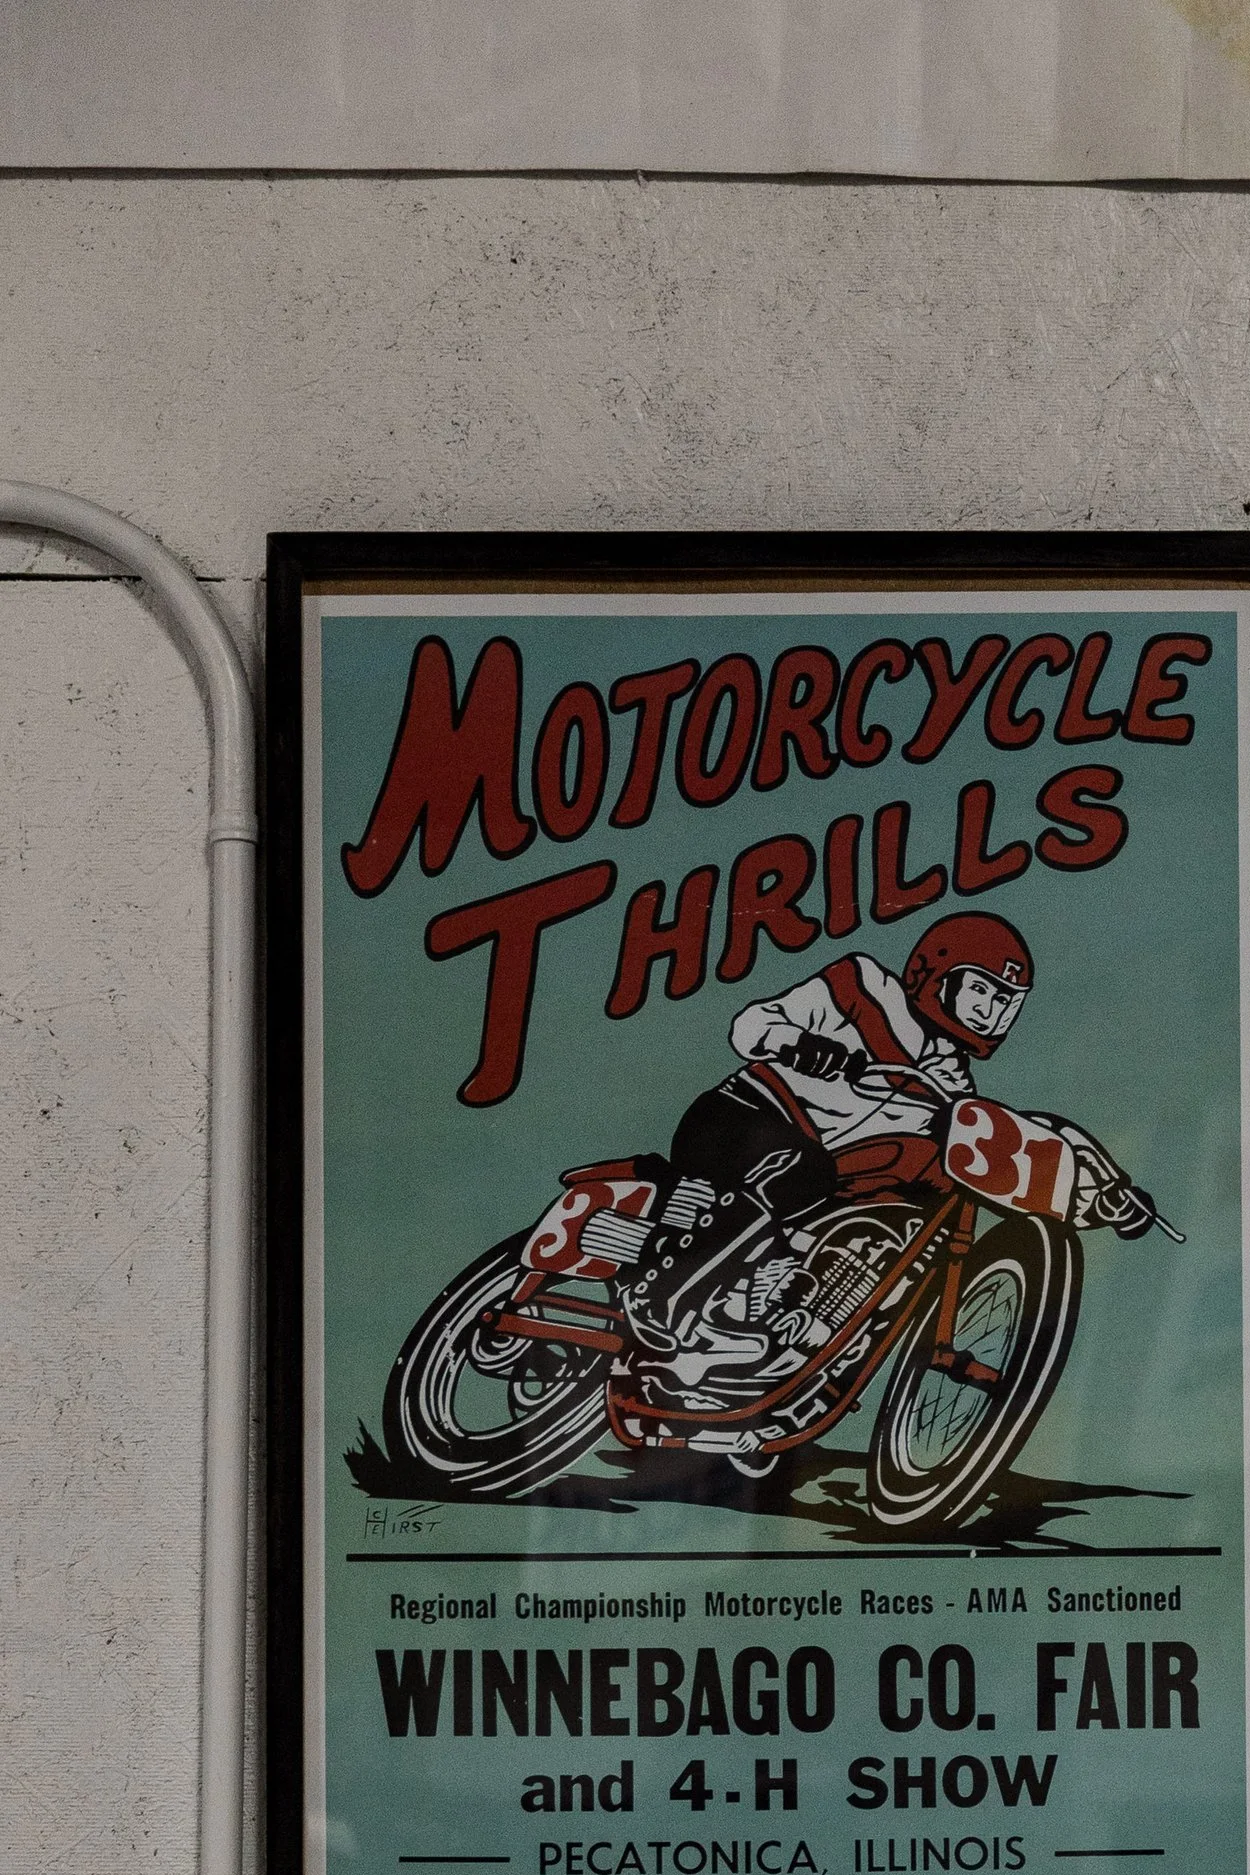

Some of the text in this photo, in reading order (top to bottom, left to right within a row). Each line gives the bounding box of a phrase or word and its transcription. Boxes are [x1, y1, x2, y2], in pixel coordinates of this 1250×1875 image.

[342, 632, 1212, 898] MOTORCYCLE
[424, 765, 1128, 1109] THRILLS
[950, 1103, 1066, 1218] 31
[389, 1593, 496, 1624] Regional
[515, 1591, 686, 1625] Championship
[704, 1589, 842, 1621] Motorcycle
[859, 1588, 934, 1616] Races
[966, 1587, 1028, 1614] AMA
[1046, 1585, 1182, 1614] Sanctioned
[375, 1641, 1199, 1739] WINNEBAGO CO. FAIR
[519, 1758, 635, 1814] and
[845, 1753, 1058, 1811] SHOW
[854, 1837, 1026, 1874] ILLINOIS
